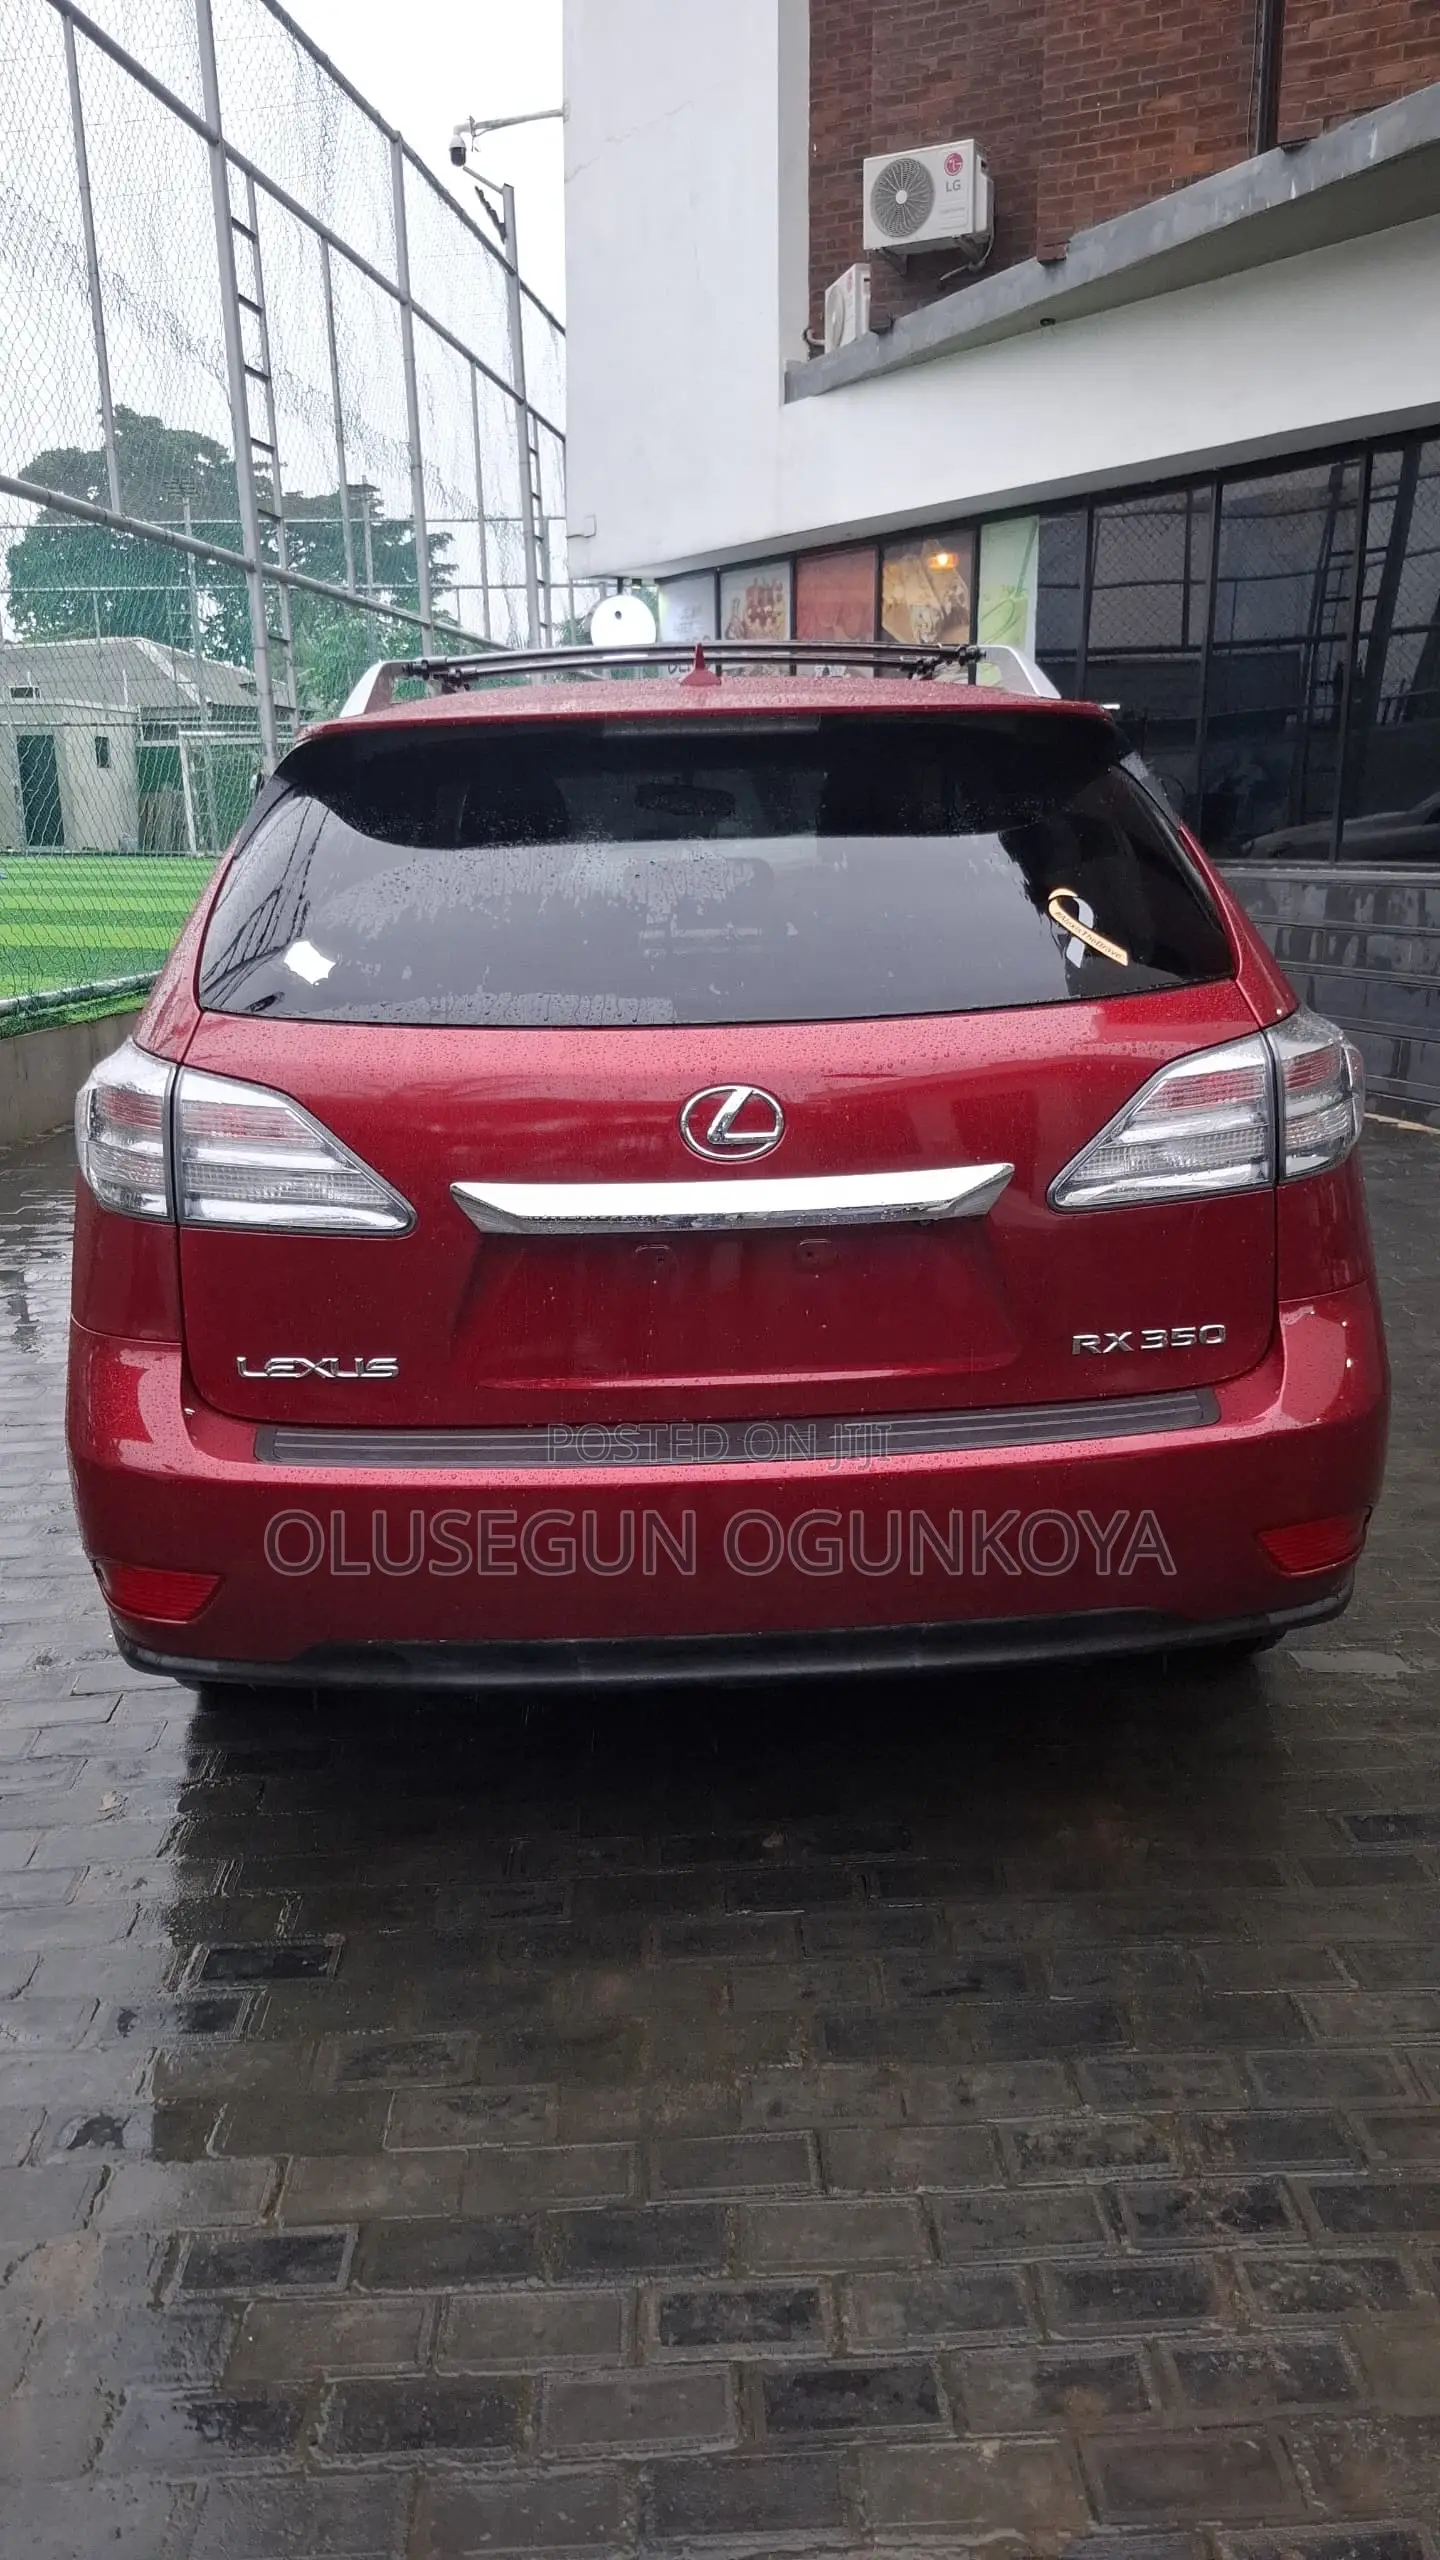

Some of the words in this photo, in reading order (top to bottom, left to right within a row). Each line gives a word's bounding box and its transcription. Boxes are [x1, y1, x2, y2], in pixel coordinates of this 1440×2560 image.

[946, 179, 961, 193] LG
[1072, 1331, 1134, 1355] RX
[1140, 1324, 1226, 1350] 350
[236, 1356, 399, 1379] LEXUS
